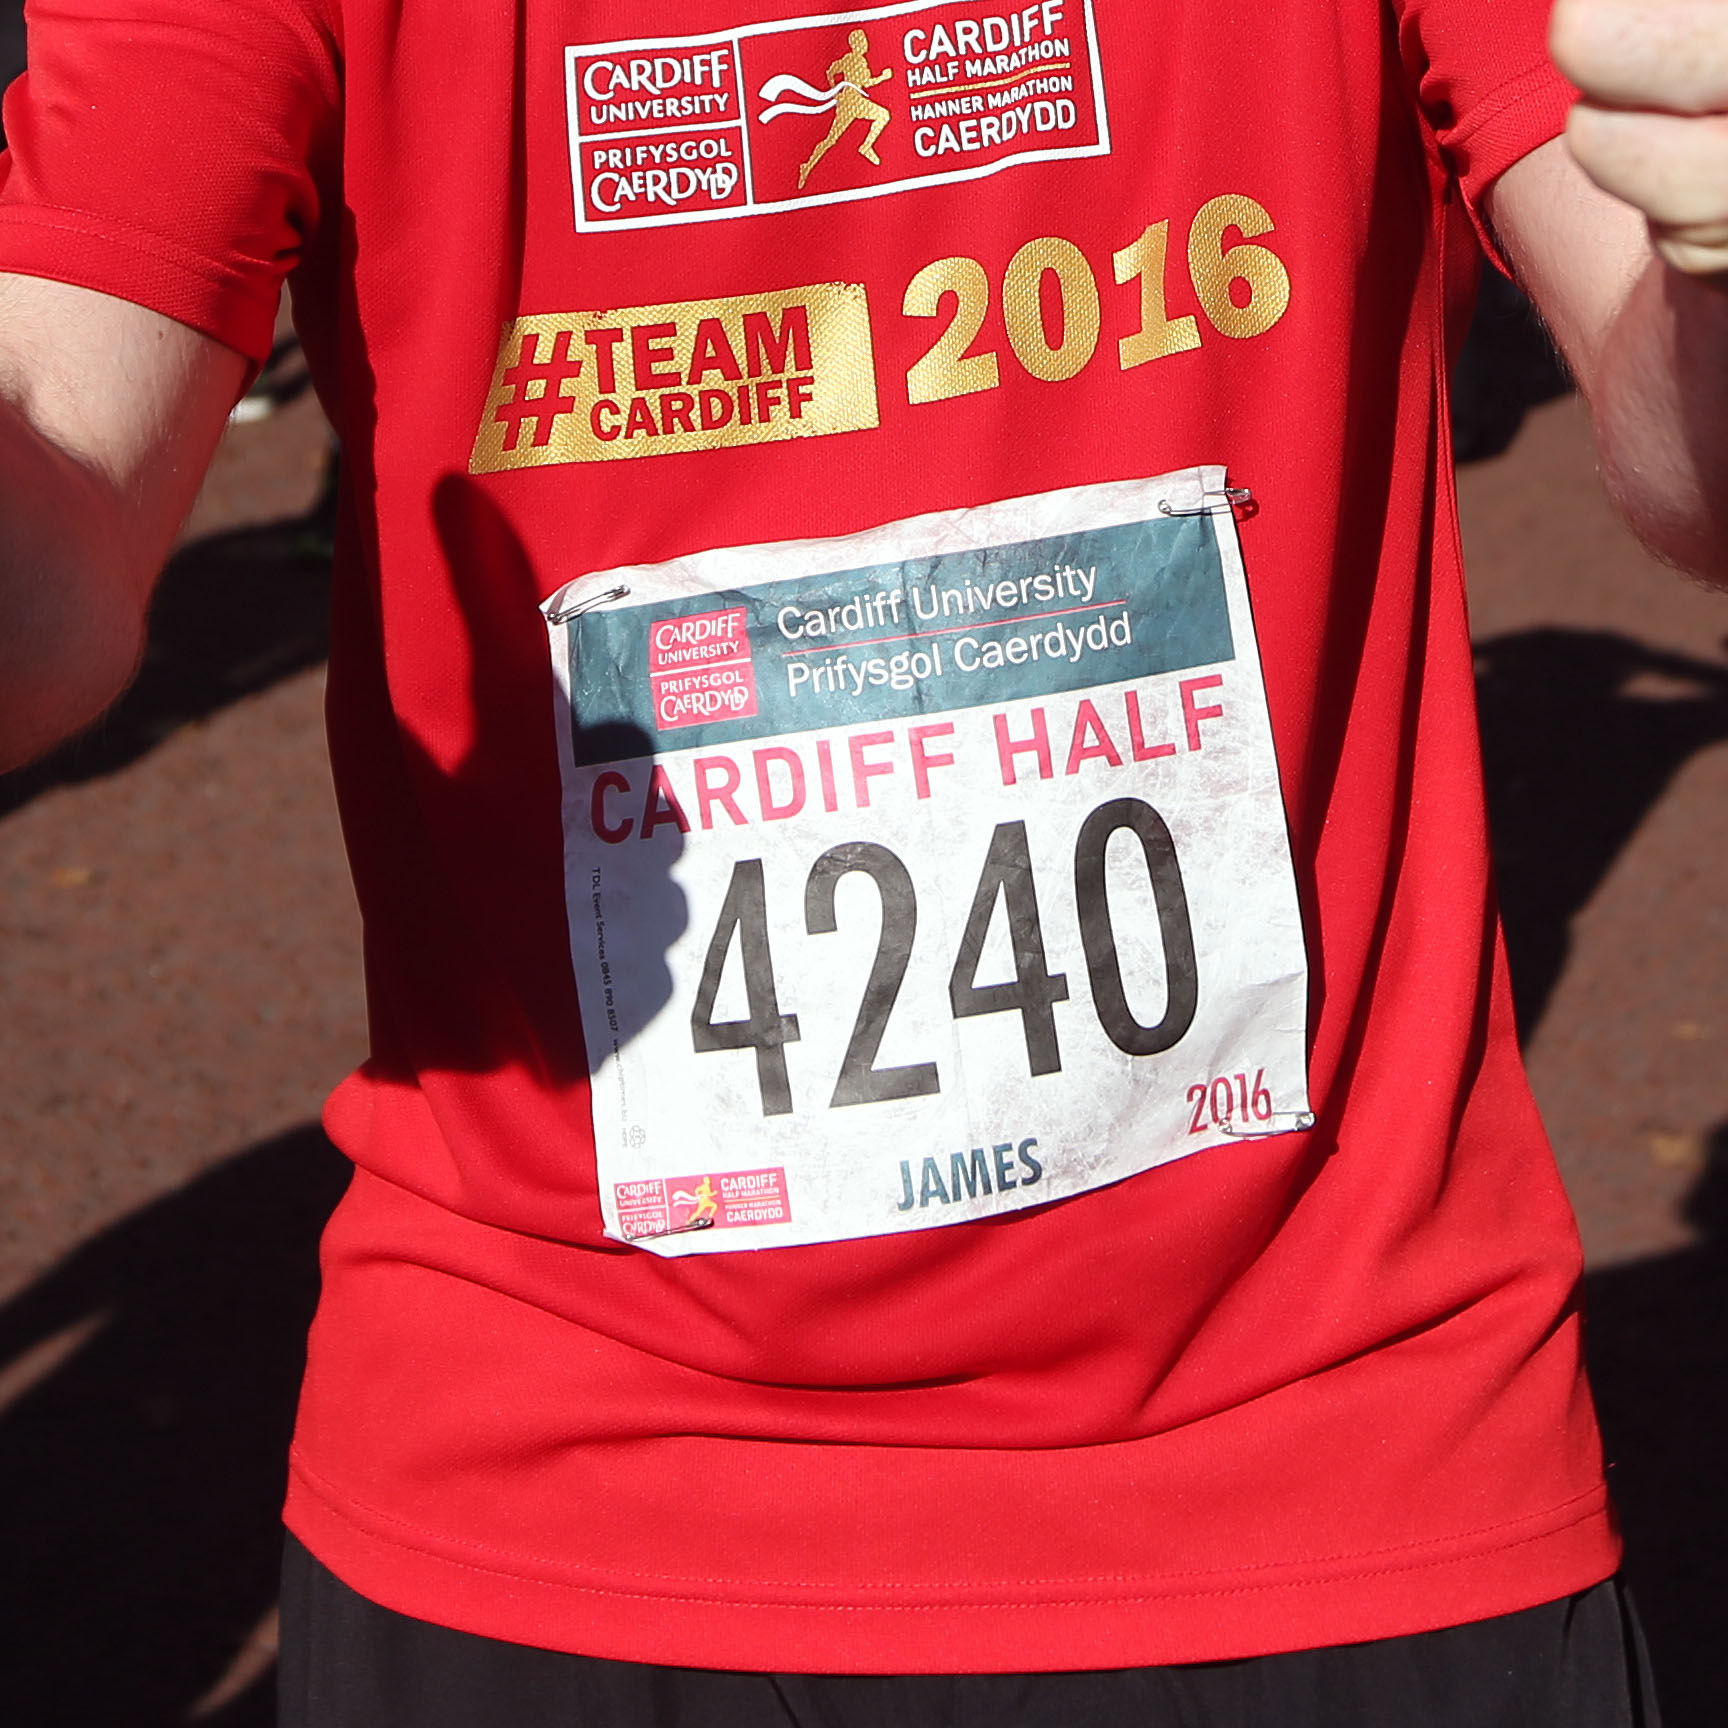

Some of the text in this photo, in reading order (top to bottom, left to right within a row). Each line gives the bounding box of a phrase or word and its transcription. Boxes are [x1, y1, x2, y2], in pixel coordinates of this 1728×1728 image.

[583, 49, 730, 101] CARDIFF
[907, 37, 1071, 88] HALF MARATHON
[590, 92, 730, 125] UNIVERSITY
[909, 75, 1074, 122] HANNER MARATHON
[913, 98, 1077, 158] CAERDYDD
[593, 137, 732, 170] PRIFYSGOL
[590, 162, 738, 214] CAERDYDD
[901, 192, 1292, 407] 2016
[494, 305, 813, 452] #TEAM
[590, 376, 814, 444] CARDIFF
[776, 562, 1098, 641] Cardiff University
[655, 613, 741, 650] CARDIFF
[658, 640, 740, 665] UNIVERSITY
[787, 610, 1134, 701] Prifysgol Caerdydd
[660, 670, 744, 695] PRIFYSGOL
[659, 685, 749, 722] CAERDYDD
[589, 673, 1226, 844] CARDIFF HALF
[591, 866, 601, 891] TDL
[592, 892, 603, 920] Event
[596, 920, 606, 961] Services
[690, 796, 1199, 1118] 4240
[600, 961, 613, 987] 0845
[606, 1008, 619, 1032] 8507
[1184, 1067, 1273, 1136] 2016
[616, 1180, 663, 1199] CARDIFF
[720, 1172, 777, 1191] CARDIFF
[722, 1186, 780, 1199] HALF MARATHON
[897, 1136, 1044, 1213] JAMES
[726, 1206, 784, 1223] CAERDYDD
